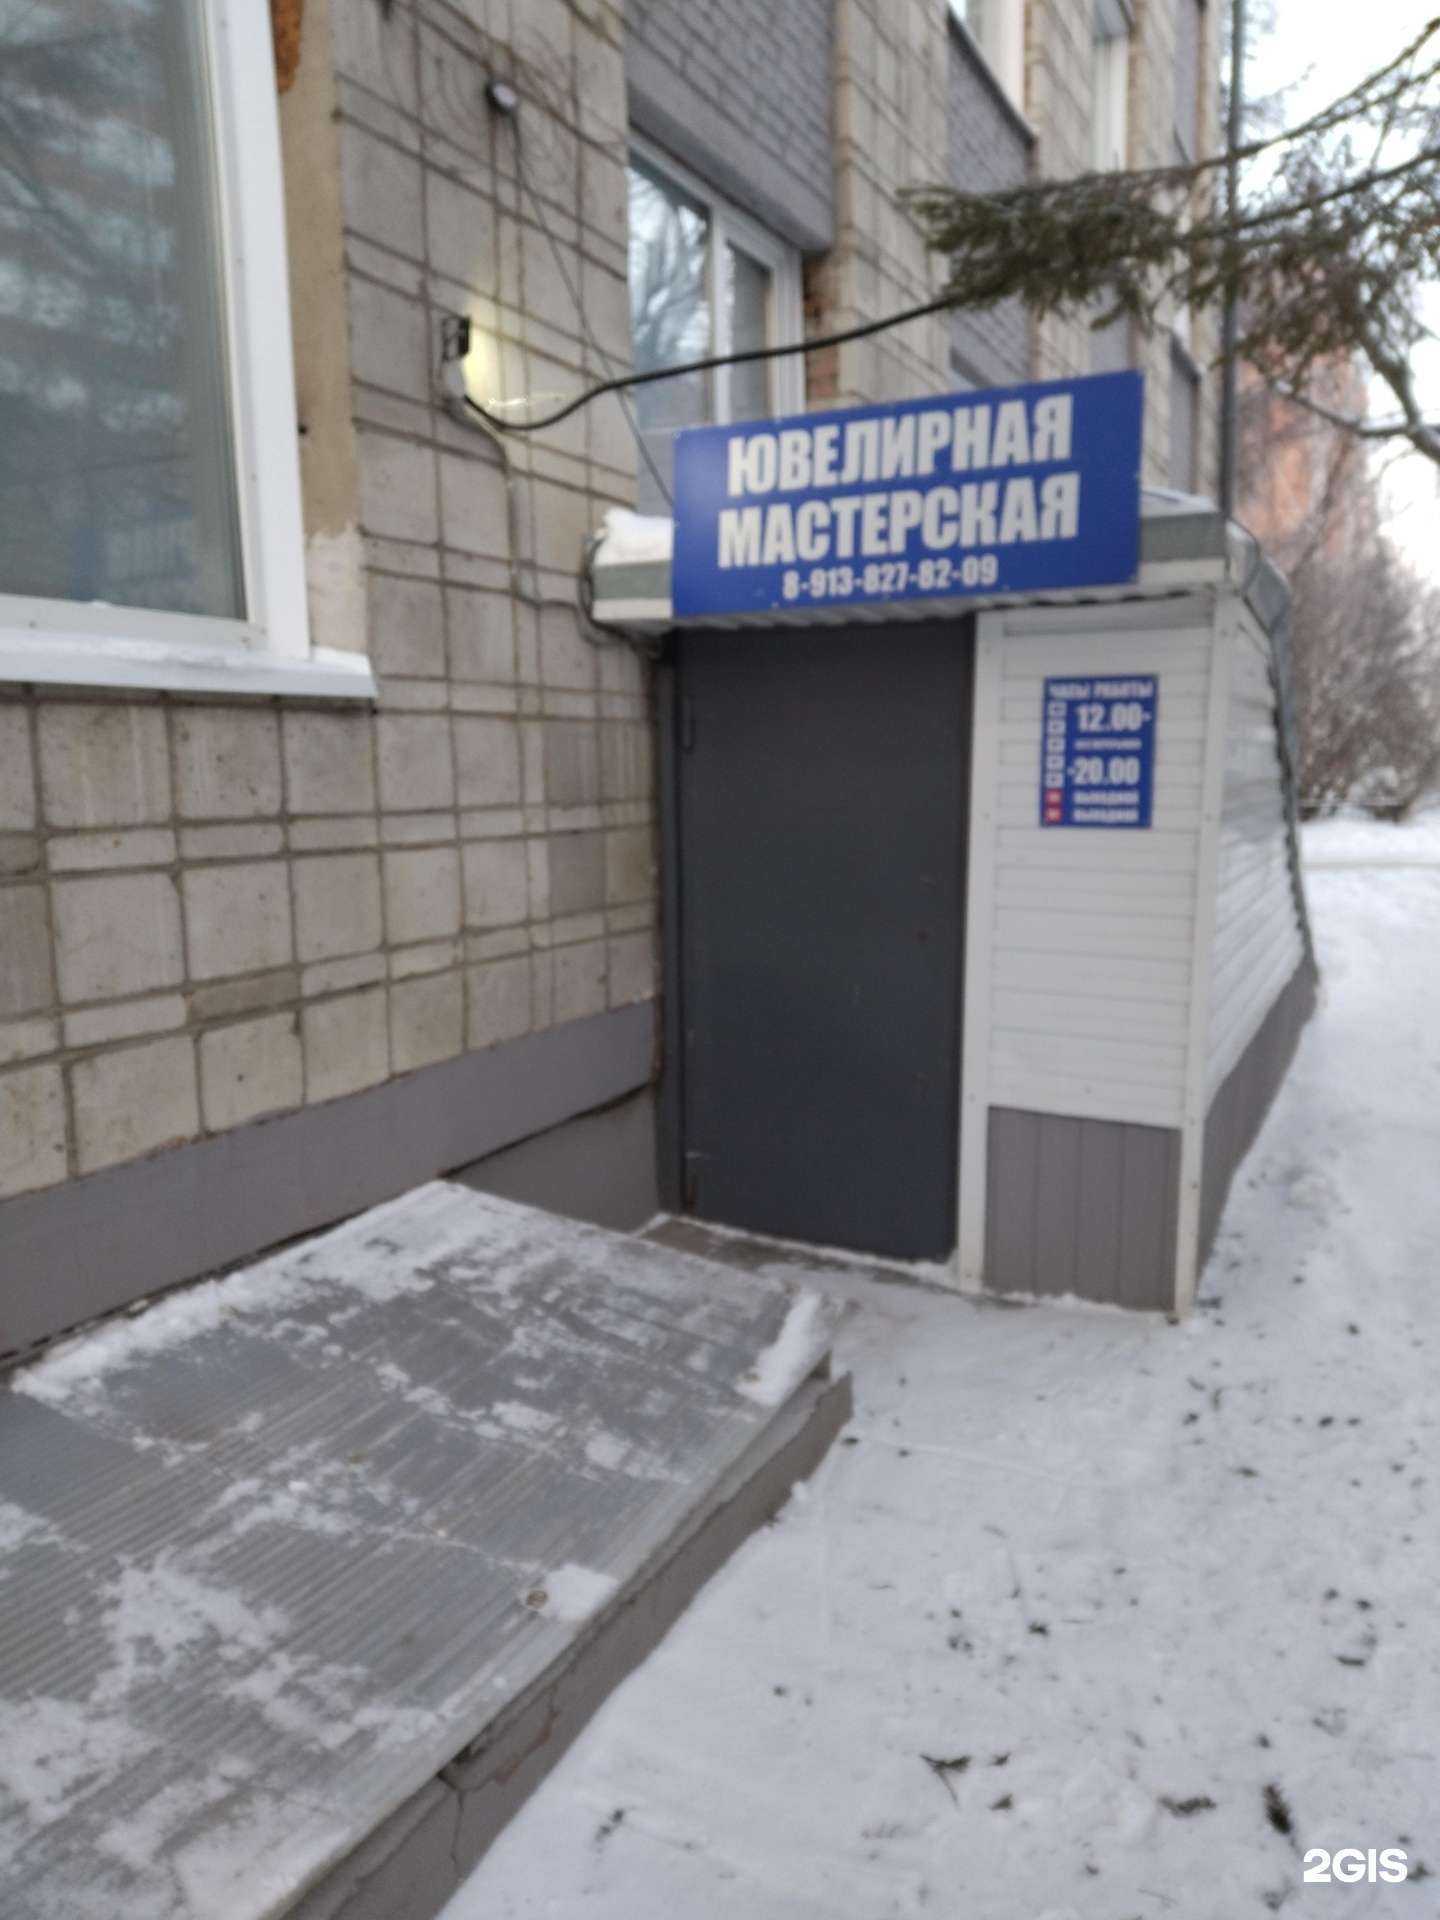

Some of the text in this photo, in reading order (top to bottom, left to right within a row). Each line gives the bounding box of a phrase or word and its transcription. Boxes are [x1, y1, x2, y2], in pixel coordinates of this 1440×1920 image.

[729, 394, 1073, 496] ЮВЕЛИРНАЯ
[719, 473, 1080, 568] МАСТЕРСКАЯ
[783, 555, 998, 599] 8-913-827-82-09
